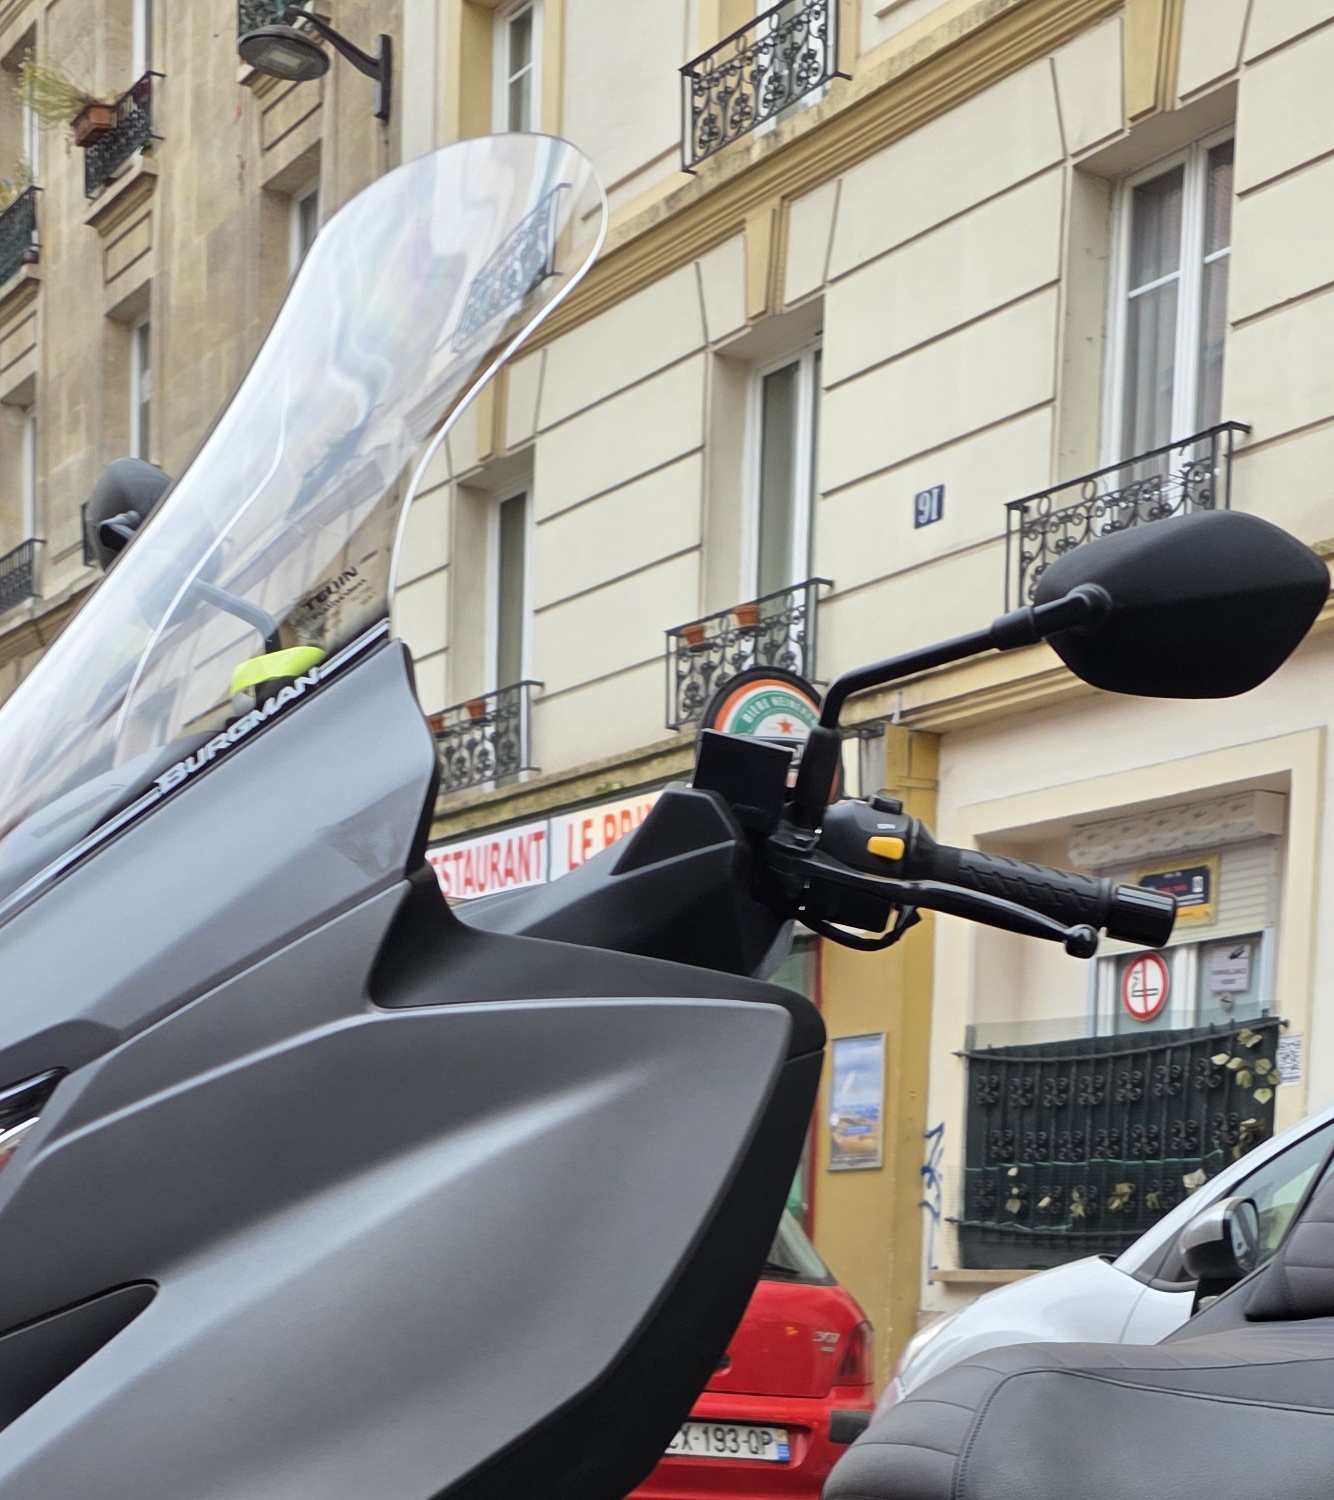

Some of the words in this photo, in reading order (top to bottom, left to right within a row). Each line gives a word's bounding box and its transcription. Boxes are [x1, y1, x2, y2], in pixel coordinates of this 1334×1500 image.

[917, 488, 939, 524] 91
[153, 667, 320, 794] BURGMAN
[568, 819, 593, 870] LE
